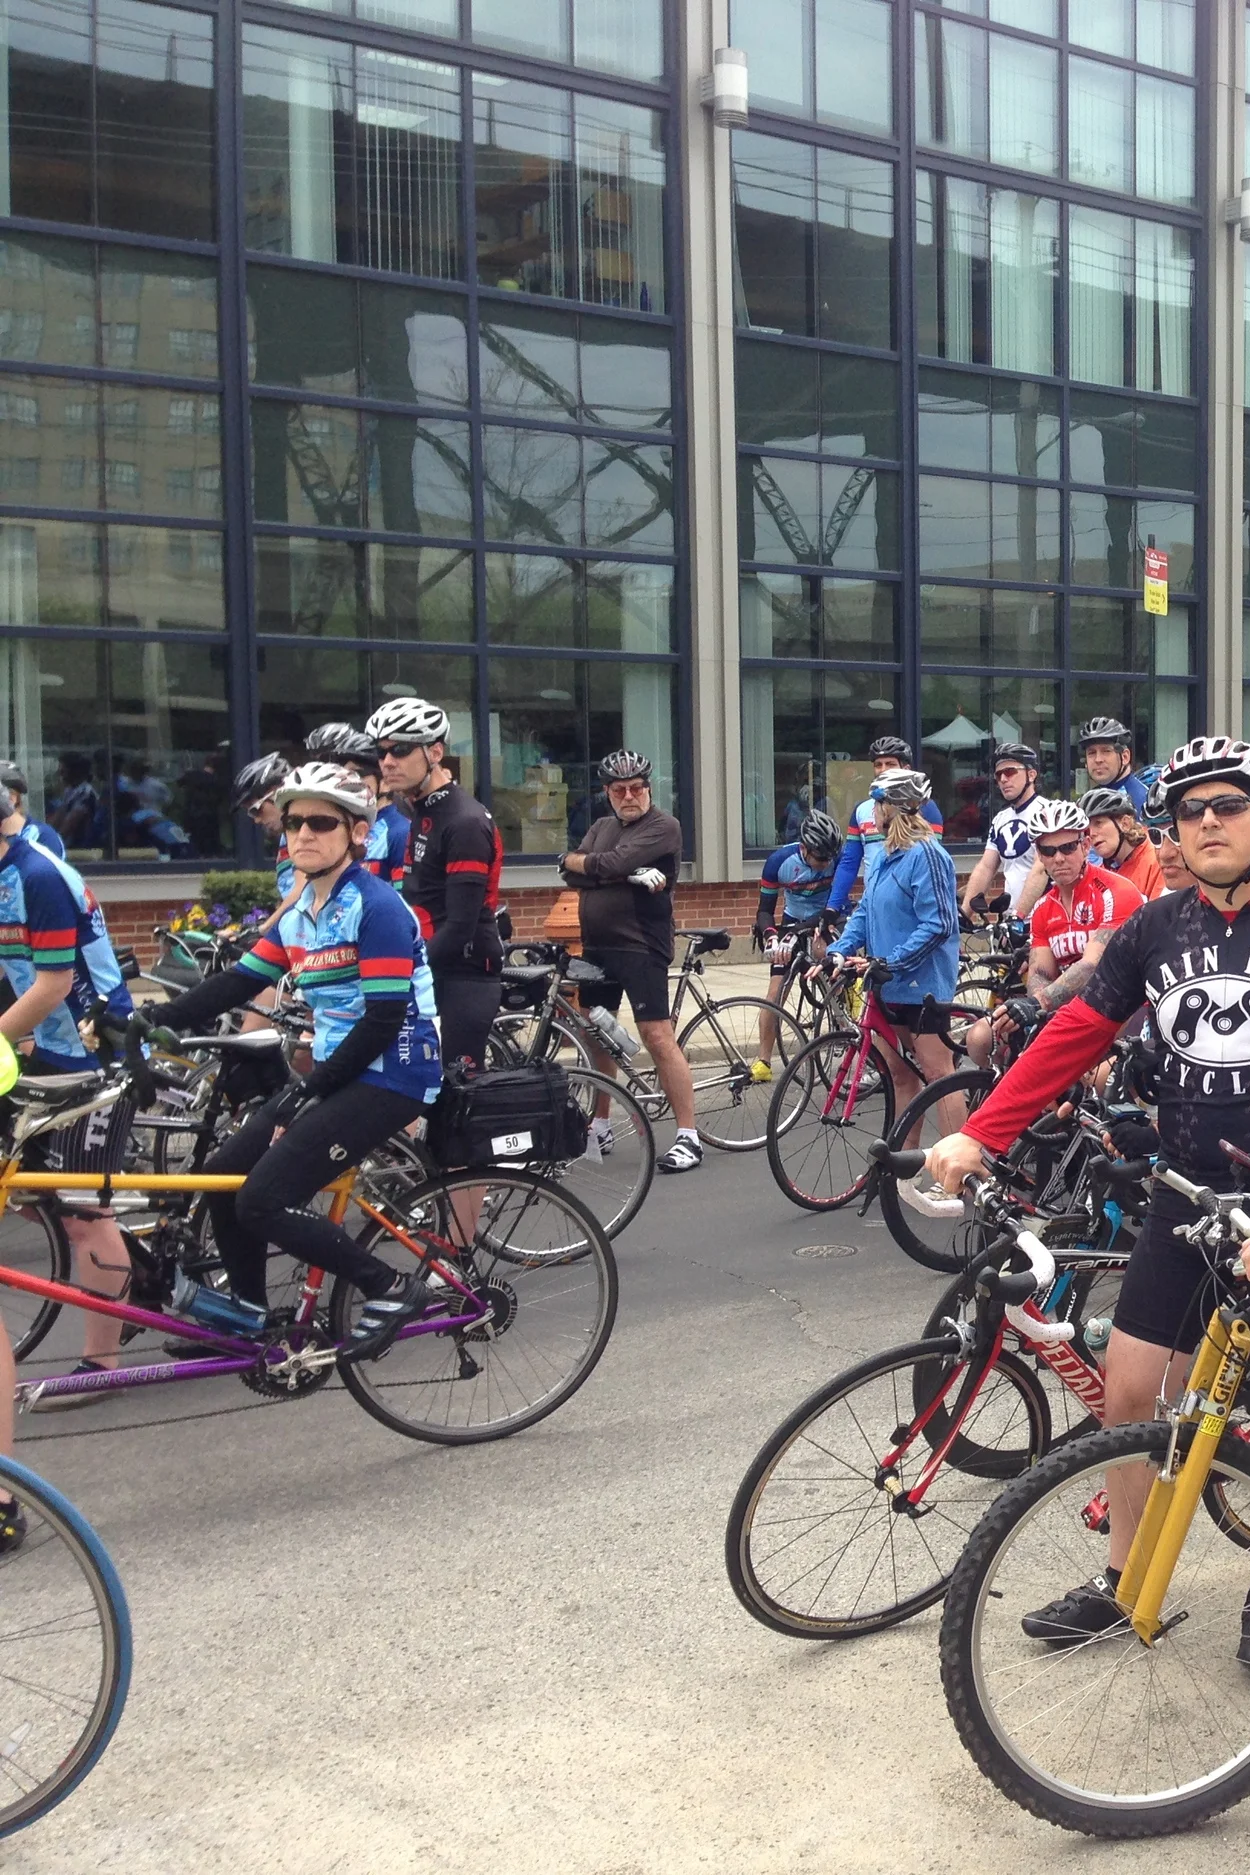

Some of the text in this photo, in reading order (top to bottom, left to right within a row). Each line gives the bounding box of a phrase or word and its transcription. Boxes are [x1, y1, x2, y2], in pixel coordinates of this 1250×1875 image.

[1145, 945, 1219, 1008] MAIN
[505, 1136, 519, 1149] 50
[114, 1365, 176, 1385] CYCLES
